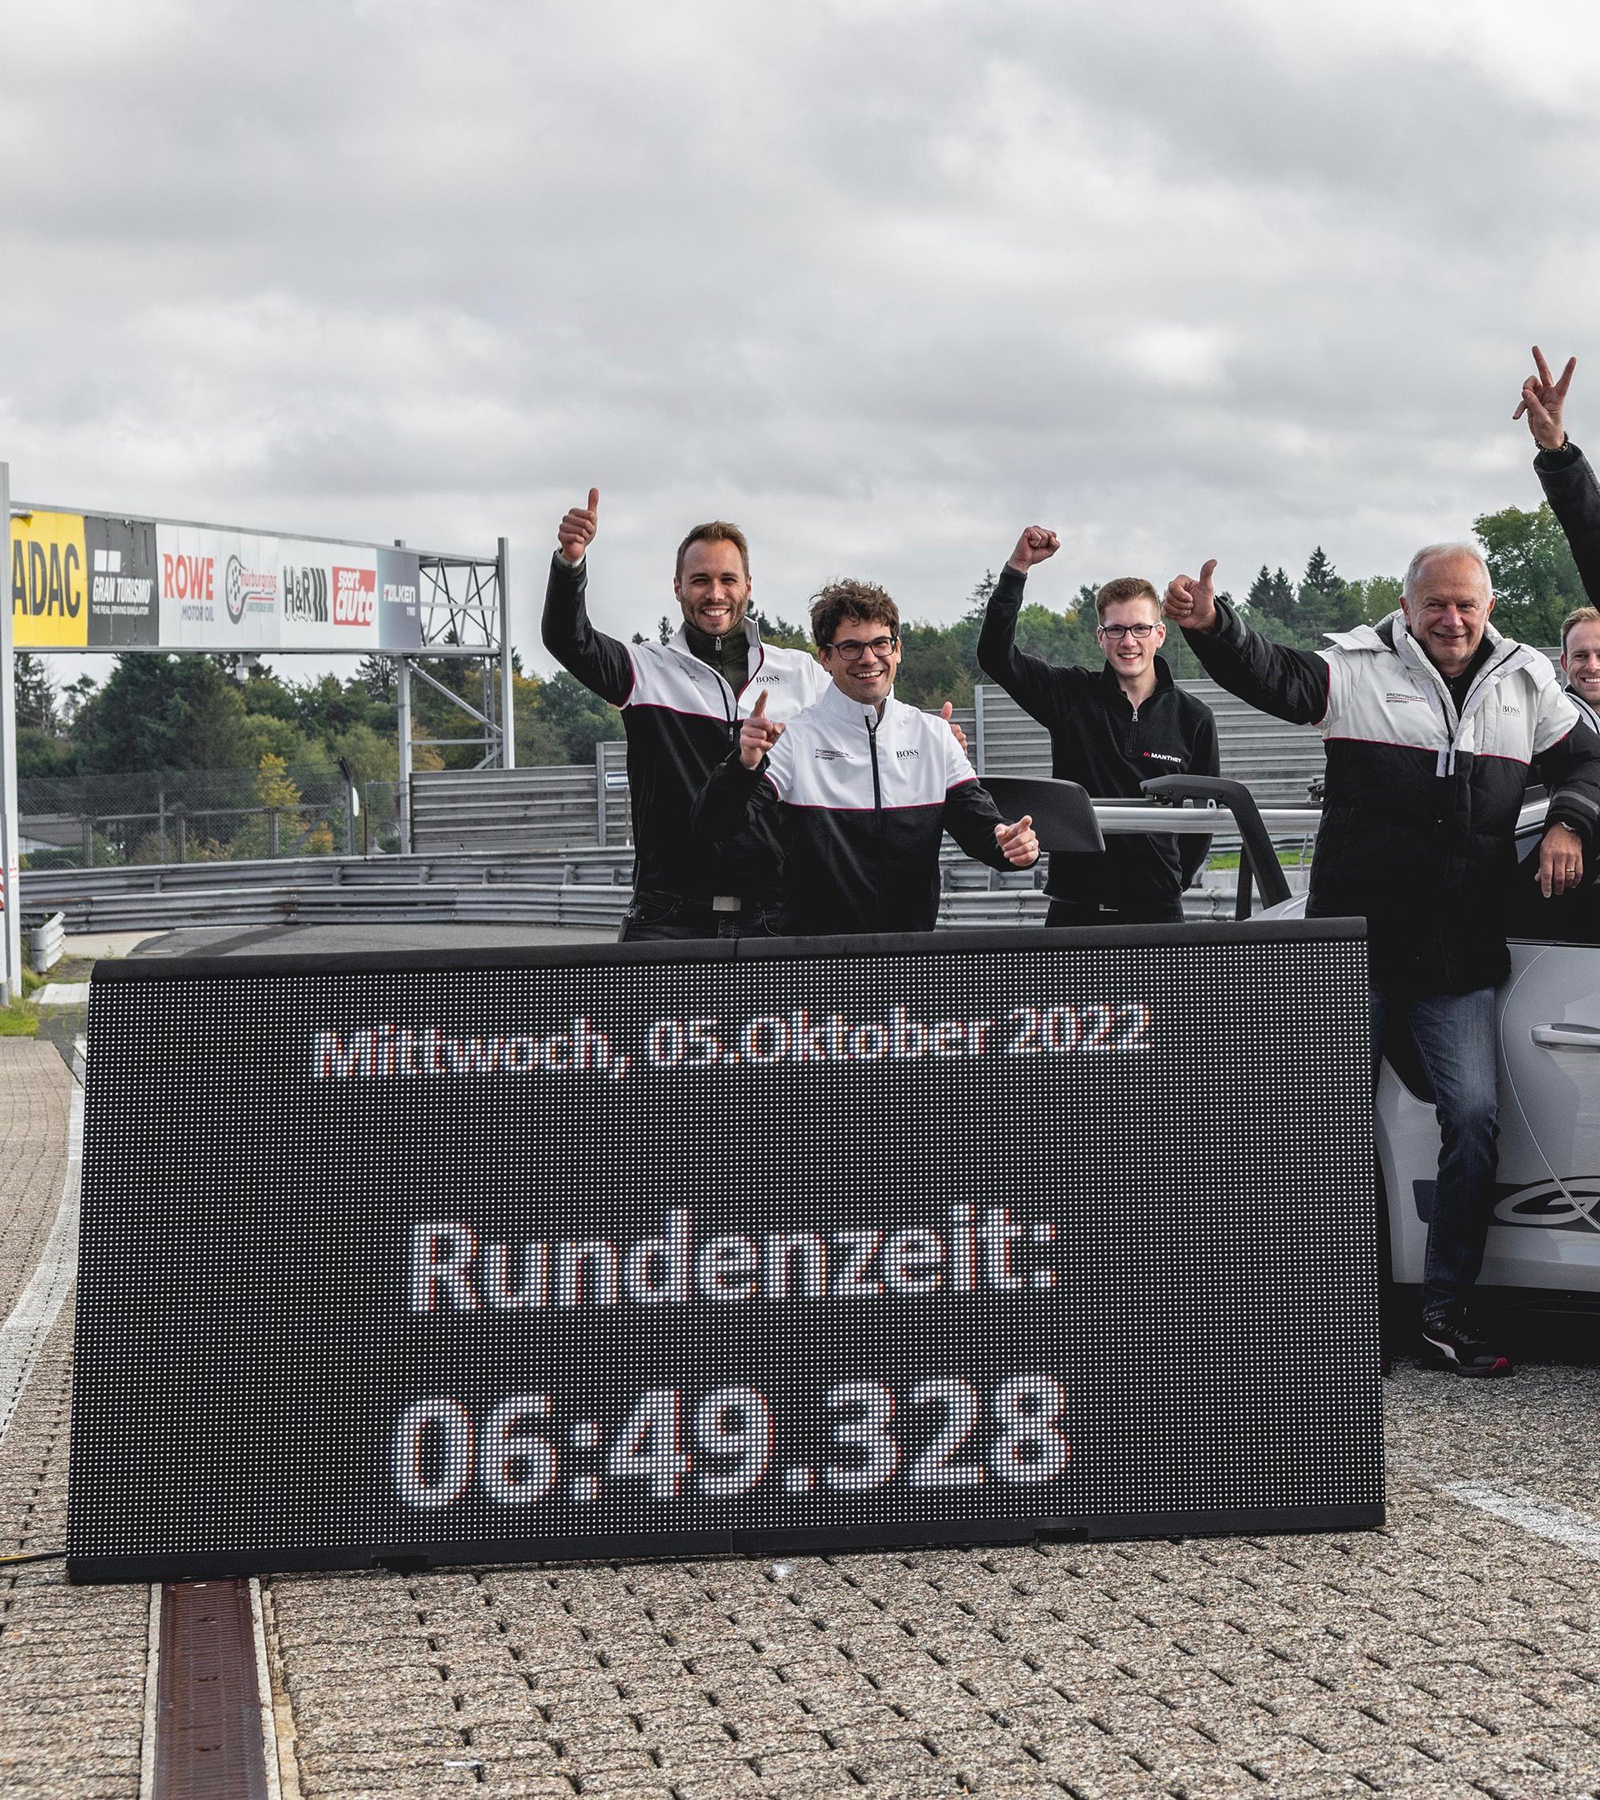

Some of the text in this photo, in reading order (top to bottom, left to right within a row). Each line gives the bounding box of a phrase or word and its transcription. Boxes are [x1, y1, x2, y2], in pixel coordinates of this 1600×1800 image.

[12, 540, 81, 618] ADAC
[92, 576, 151, 604] GRAN TURISMO
[162, 553, 214, 601] ROWE
[283, 565, 313, 622] H&R
[337, 570, 361, 593] sport
[335, 585, 376, 623] auto
[756, 675, 780, 683] BOSS
[1502, 705, 1521, 714] BOSS
[896, 749, 919, 758] BOSS
[1151, 752, 1182, 763] MANTHEY
[313, 1001, 1153, 1080] Mittwoch, 05.Oktober 2022
[408, 1203, 1057, 1311] Rundenzeit:
[392, 1373, 1071, 1509] 06:49.328
